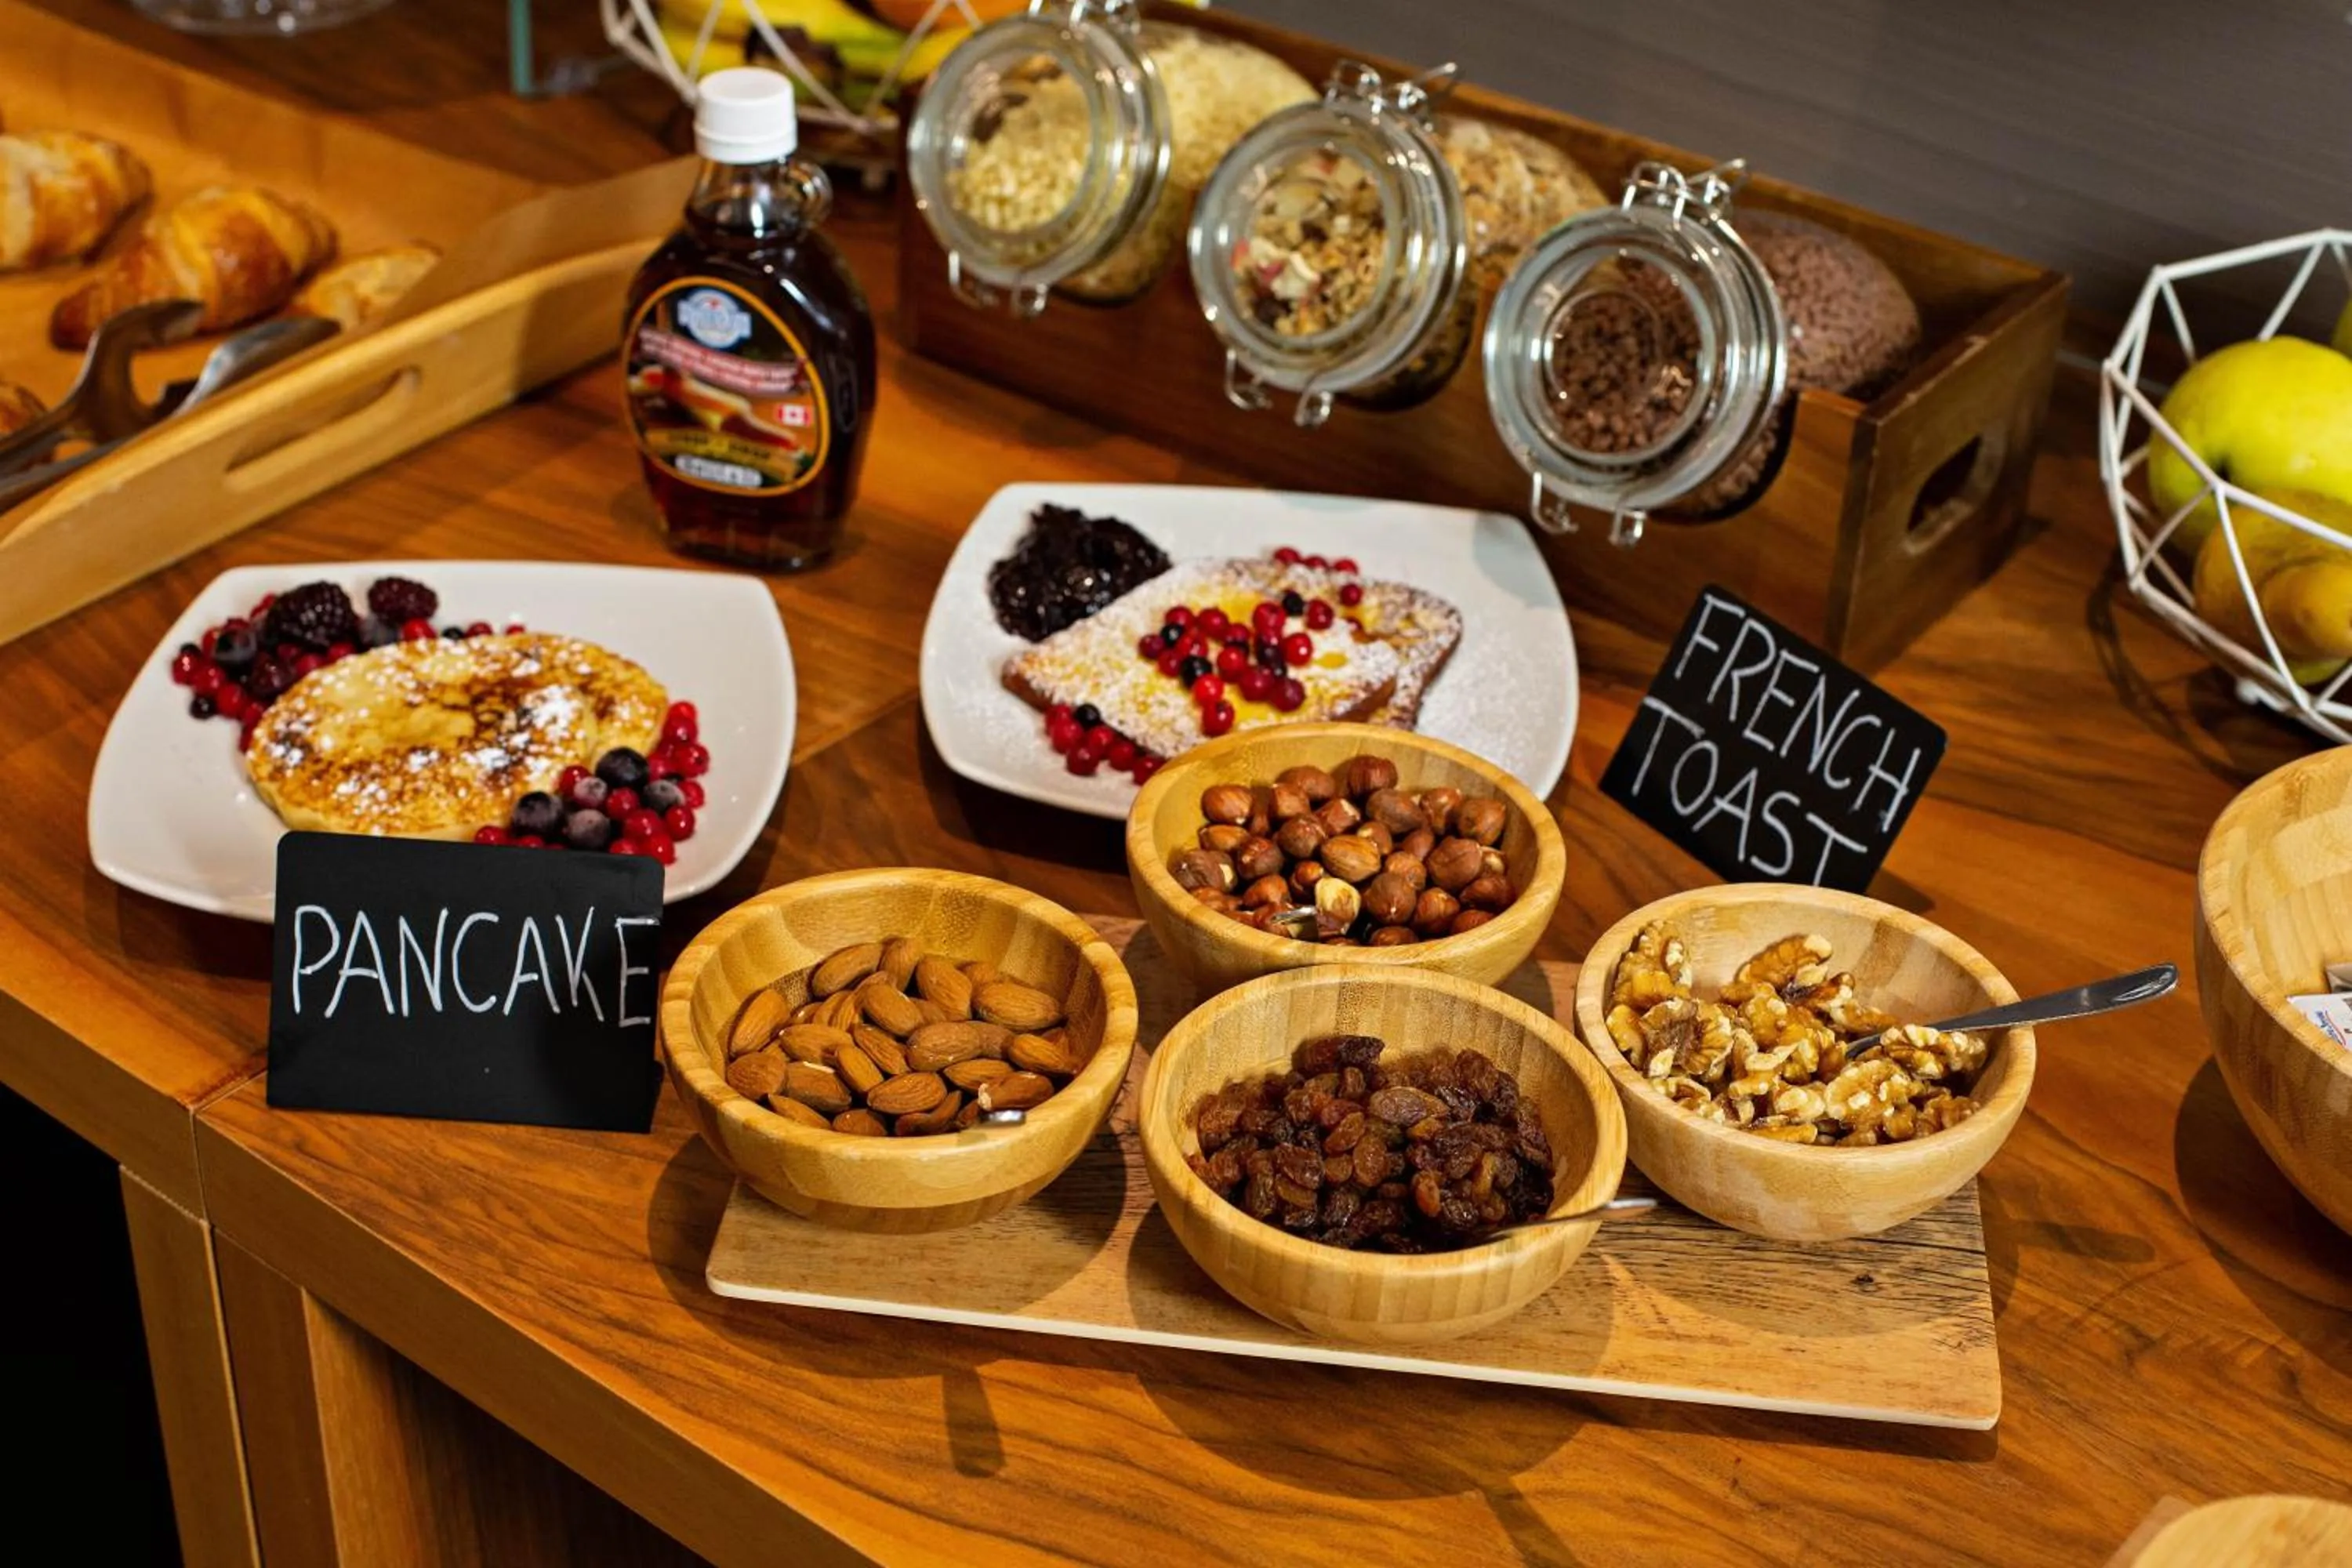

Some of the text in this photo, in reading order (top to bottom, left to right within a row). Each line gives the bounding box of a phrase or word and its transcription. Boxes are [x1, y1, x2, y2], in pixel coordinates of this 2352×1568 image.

[1632, 696, 1867, 887] TOAST
[1675, 593, 1921, 833] FRENCH
[292, 905, 659, 1028] PANCAKE
